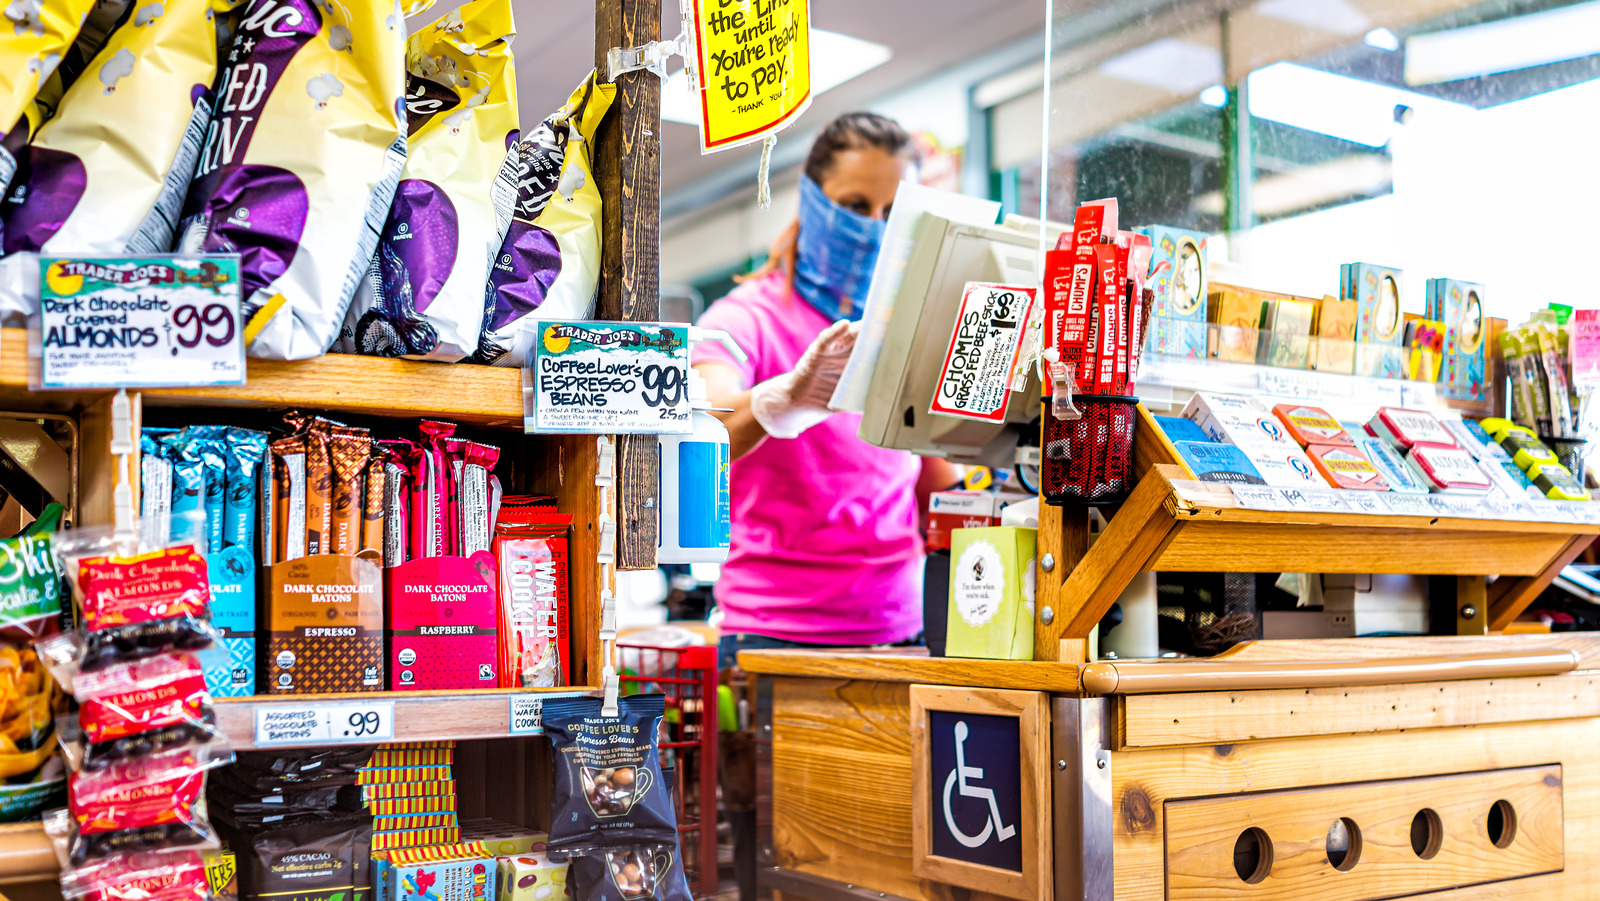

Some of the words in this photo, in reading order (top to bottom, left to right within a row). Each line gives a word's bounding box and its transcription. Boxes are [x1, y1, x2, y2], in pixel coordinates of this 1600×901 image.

[708, 10, 746, 36] the
[733, 14, 777, 45] until
[711, 43, 766, 77] You're
[768, 12, 800, 57] ready
[720, 75, 749, 101] to
[65, 263, 124, 282] TRADER
[129, 264, 168, 281] JOE'S
[1070, 266, 1089, 312] CHOMPS
[44, 297, 85, 313] Dark
[88, 294, 172, 312] Chocolate
[981, 290, 999, 320] STICK
[65, 313, 127, 326] covered
[44, 325, 159, 348] ALMONDS
[558, 326, 602, 345] TRADER
[606, 329, 636, 345] JOE'S
[973, 320, 990, 347] BEEF
[943, 311, 980, 399] CHOMPS
[965, 347, 982, 371] FED
[540, 375, 637, 394] ESPRESSO
[954, 372, 976, 409] GRASS
[550, 392, 608, 407] BEANS
[323, 502, 332, 531] DARK
[433, 493, 441, 520] DARK
[237, 513, 247, 540] DARK
[338, 522, 348, 551] DARK
[309, 541, 319, 554] ES
[434, 522, 443, 556] CHOCO
[89, 566, 125, 582] Dark
[128, 559, 198, 578] Chocolate
[103, 579, 183, 598] ALMONDS
[283, 584, 315, 594] DARK
[315, 584, 375, 594] CHOCOLATE
[404, 584, 433, 593] DARK
[434, 584, 489, 593] CHOCOLATE
[557, 561, 567, 604] CHOCOLATE
[311, 593, 352, 603] BATONS
[430, 593, 467, 602] BATONS
[509, 559, 535, 640] COOKIE
[533, 560, 558, 639] WAFER
[304, 627, 357, 637] ESPRESSO
[420, 625, 475, 635] RASPBERRY
[558, 605, 568, 640] COVERED
[104, 685, 179, 707] ALMONDS
[263, 719, 318, 732] CHOCOLATE
[265, 710, 316, 722] ASSORTED
[343, 710, 380, 737] .99
[567, 723, 600, 735] COFFEE
[584, 717, 603, 725] TRADER
[575, 732, 608, 746] Espresso
[608, 734, 635, 745] Beans
[611, 746, 636, 754] ESPRESSO
[636, 743, 653, 752] BEANS
[572, 757, 590, 765] SWEET
[590, 758, 608, 766] COFFEE
[607, 756, 644, 765] COMBINATIONS
[99, 783, 174, 803] ALMONDS
[271, 864, 285, 873] Net
[285, 863, 313, 872] effective
[315, 861, 332, 870] carbs
[298, 852, 332, 862] CACAO
[464, 865, 472, 879] ON
